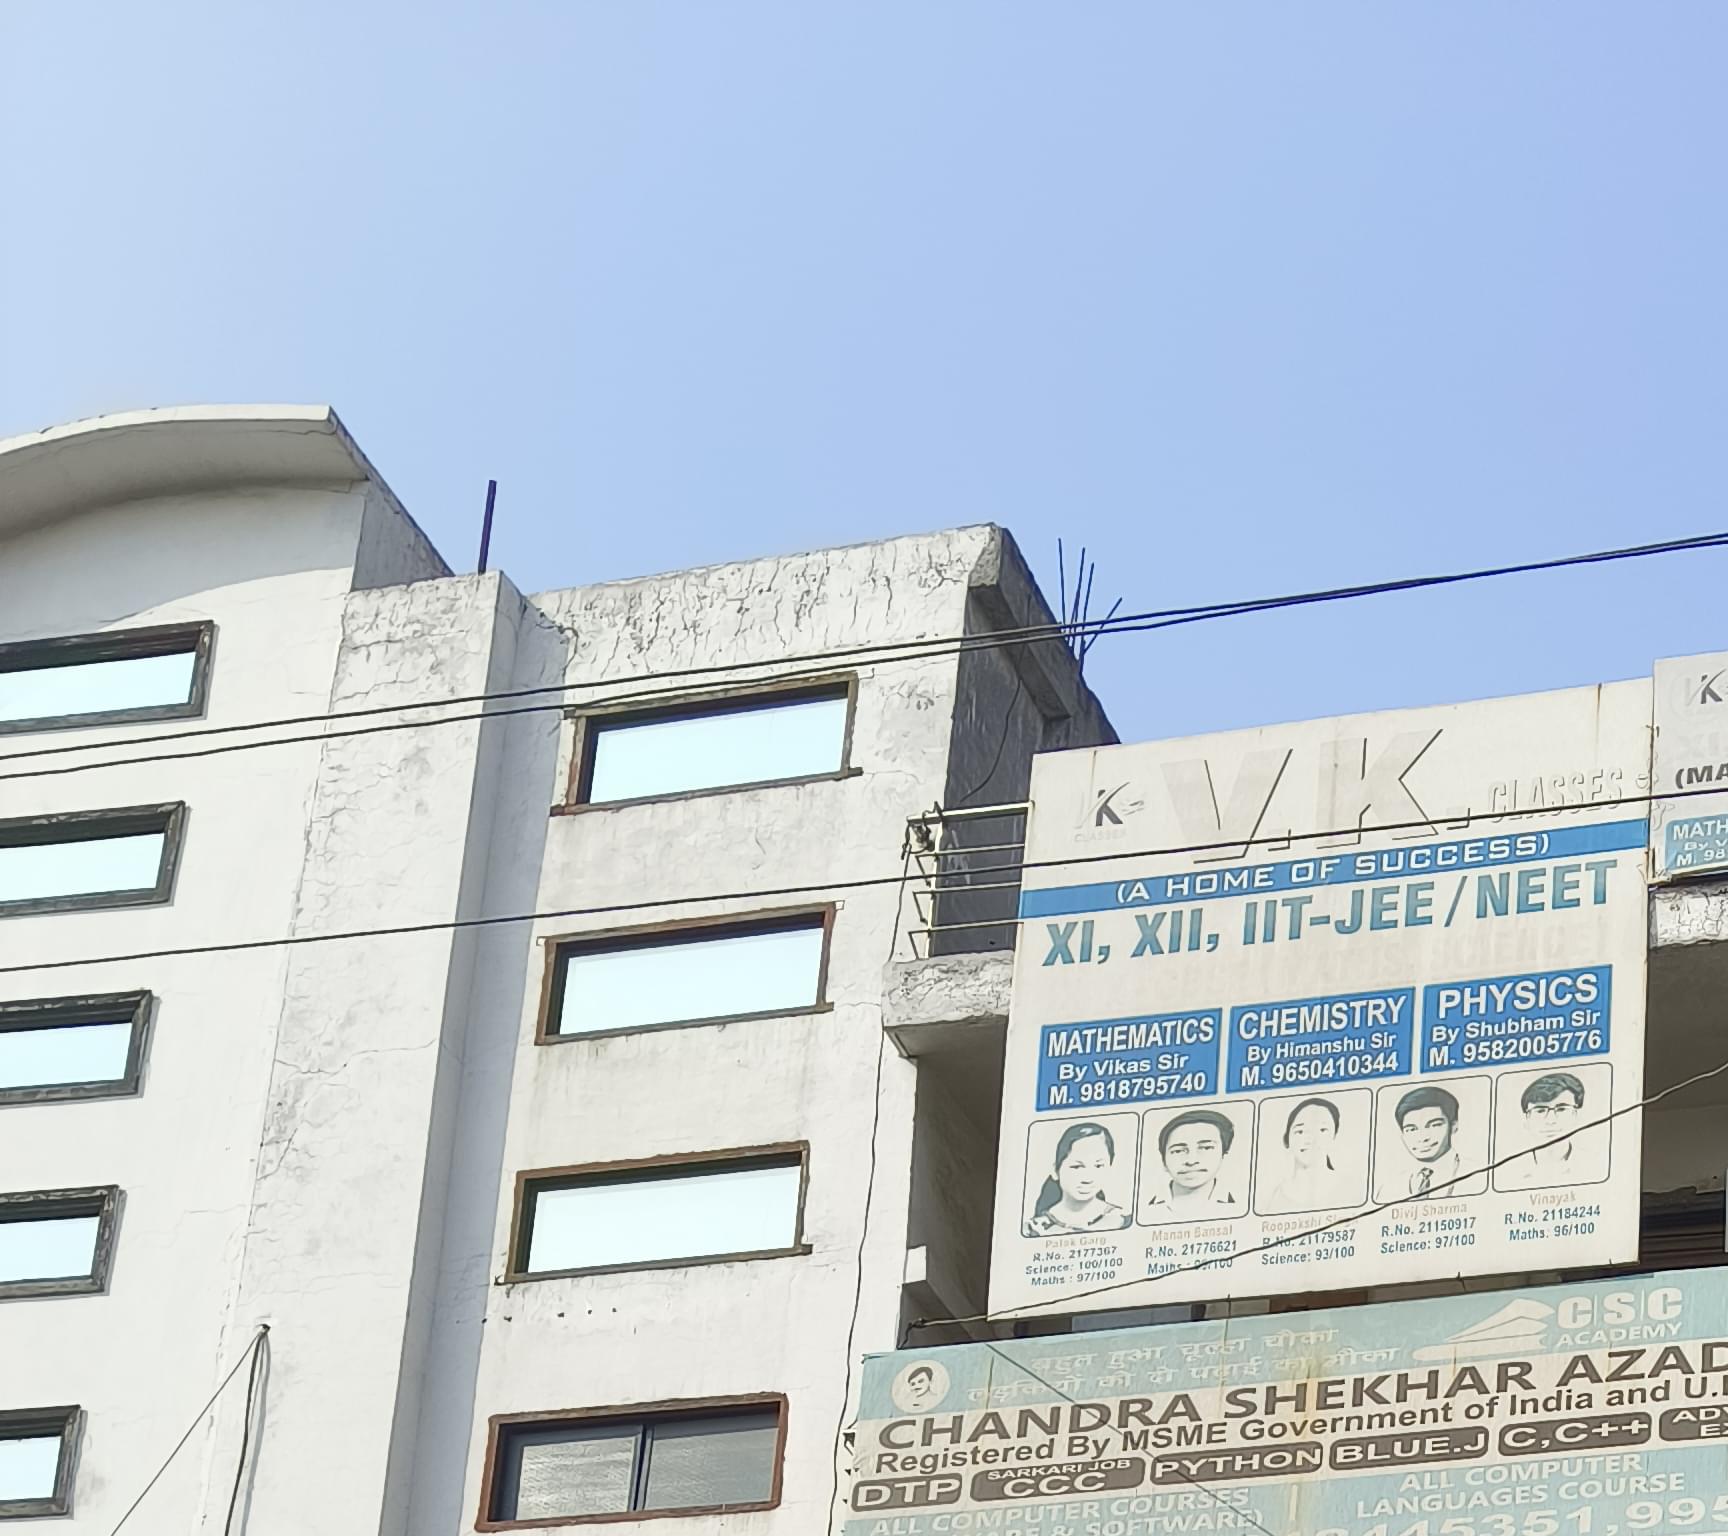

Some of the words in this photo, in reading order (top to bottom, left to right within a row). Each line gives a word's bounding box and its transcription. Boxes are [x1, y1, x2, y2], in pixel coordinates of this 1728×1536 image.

[1116, 881, 1149, 905] (A
[1165, 865, 1275, 900] HOME
[1291, 858, 1341, 883] OF
[1355, 833, 1551, 876] SUCCESS)
[1042, 919, 1111, 967] XI,
[1130, 907, 1220, 958] XII,
[1438, 974, 1598, 1019] PHYSICS
[1048, 1016, 1215, 1057] MATHEMATICS
[1239, 996, 1407, 1041] CHEMISTRY
[1431, 1025, 1460, 1045] By
[1466, 1015, 1567, 1038] Shubham
[1571, 1008, 1601, 1026] Sir
[1247, 1042, 1272, 1064] By
[1276, 1036, 1366, 1059] Himanshu
[1370, 1032, 1396, 1051] Sir
[1428, 1046, 1457, 1067] M.
[1462, 1030, 1602, 1064] 9582005776
[1059, 1062, 1088, 1084] By
[1093, 1056, 1153, 1078] Vikas
[1157, 1052, 1189, 1071] Sir
[1241, 1066, 1265, 1088] M.
[1271, 1052, 1399, 1085] 9650410344
[1049, 1085, 1074, 1106] M.
[1079, 1072, 1206, 1104] 9818795740
[1382, 1224, 1415, 1237] R.No.
[1419, 1217, 1476, 1234] 21150917
[1435, 1234, 1475, 1248] 97/100
[879, 1392, 1203, 1452] CHANDRA
[1224, 1361, 1537, 1420] SHEKHAR
[876, 1440, 1055, 1474] Registered
[1067, 1437, 1108, 1461] By
[1122, 1424, 1228, 1450] MSME
[1240, 1405, 1453, 1442] Government
[1462, 1396, 1500, 1422] of
[1509, 1383, 1594, 1414] India
[1606, 1381, 1671, 1407] and
[1337, 1430, 1486, 1462] BLUE.J
[1155, 1448, 1322, 1482] PYTHON
[857, 1478, 961, 1507] DTP
